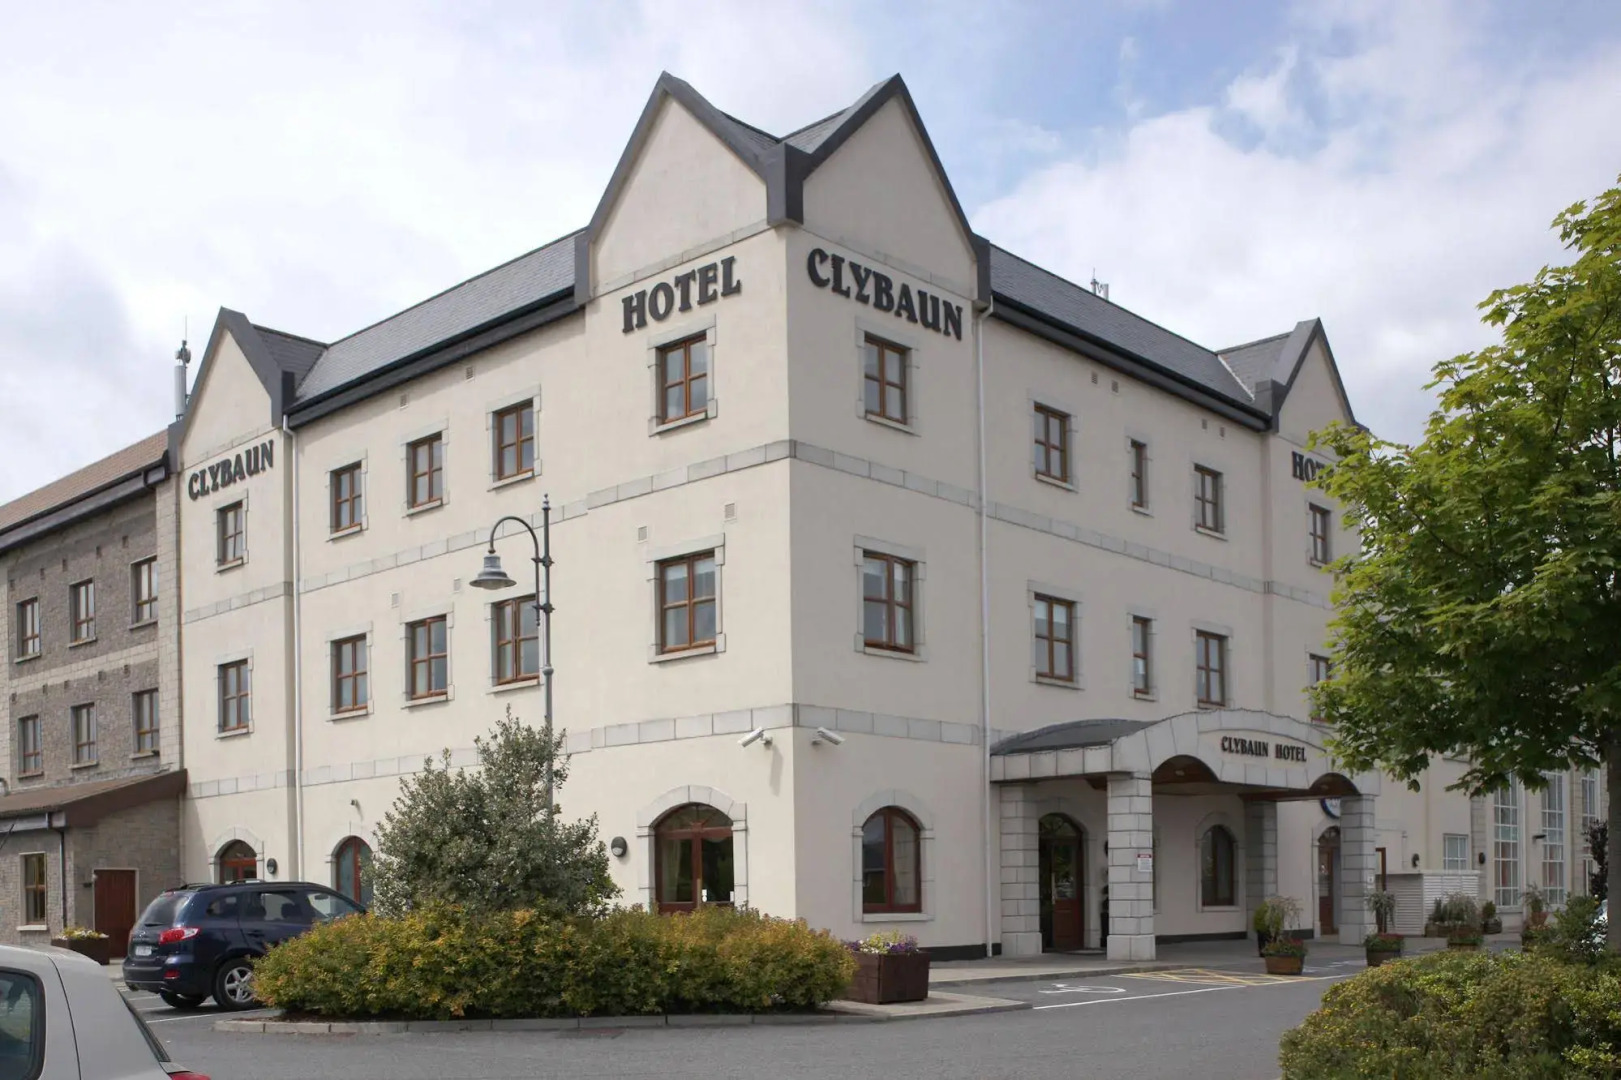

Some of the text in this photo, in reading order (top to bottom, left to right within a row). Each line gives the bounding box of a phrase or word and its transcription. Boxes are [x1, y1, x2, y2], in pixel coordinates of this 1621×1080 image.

[621, 255, 742, 334] HOTEL
[807, 248, 964, 341] CLYBAUN
[188, 439, 274, 501] CLYBAUN
[1221, 736, 1307, 762] CLYBAUN HOTEL
